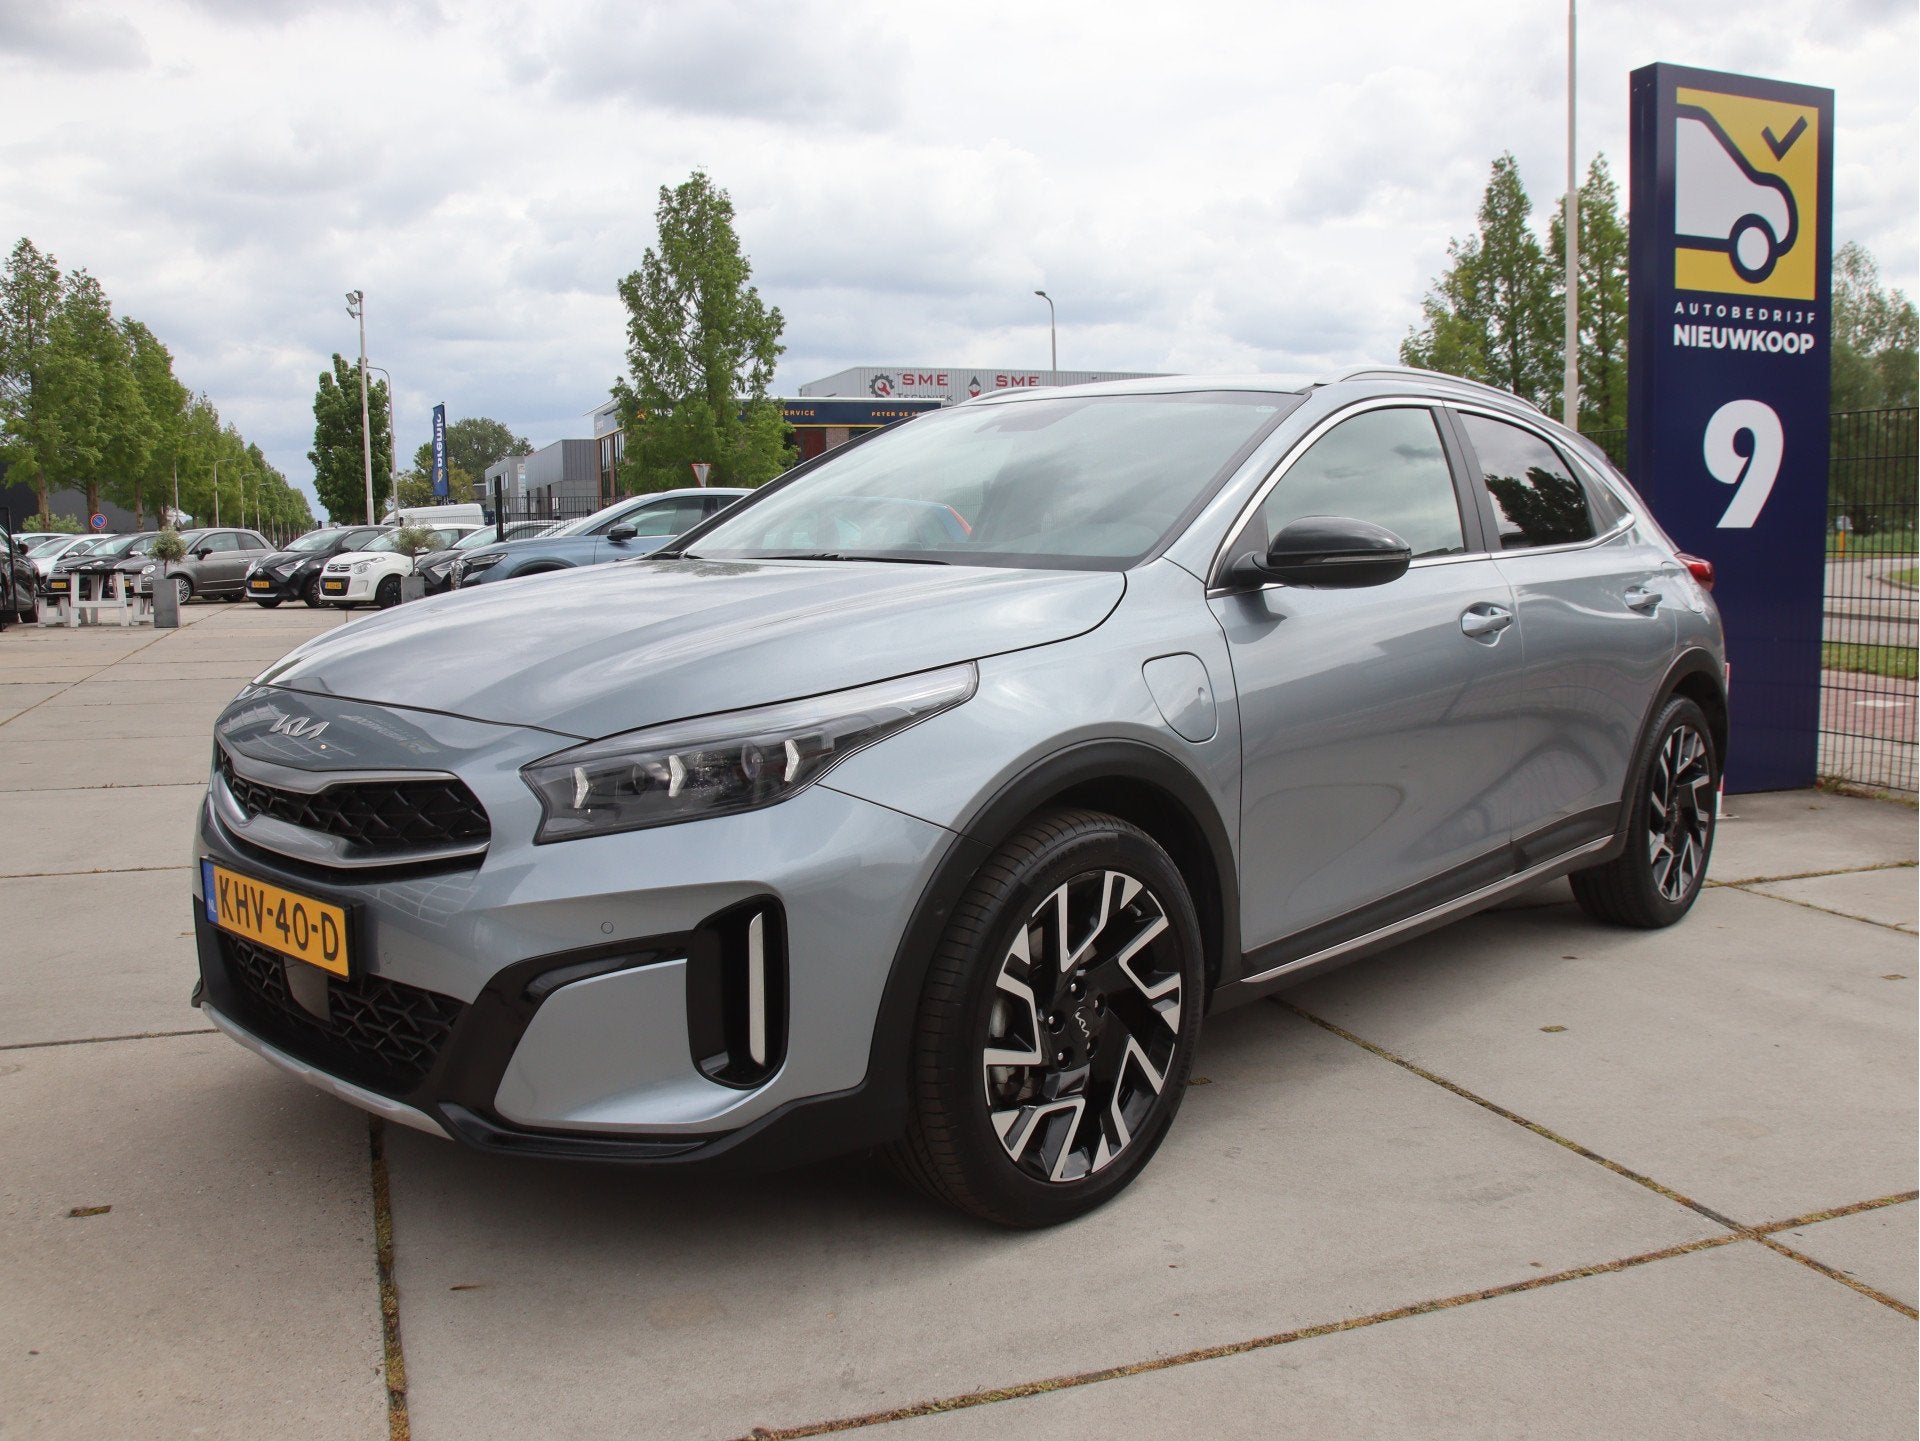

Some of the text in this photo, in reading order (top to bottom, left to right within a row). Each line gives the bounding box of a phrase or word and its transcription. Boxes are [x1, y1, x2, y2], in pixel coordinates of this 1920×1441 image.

[1674, 301, 1815, 324] AUTOBEDRIJF
[1674, 324, 1815, 354] NIEUWKOOP
[902, 373, 949, 386] SME
[996, 375, 1040, 387] SME
[1703, 399, 1784, 528] 9
[219, 875, 339, 962] KHV-40-D
